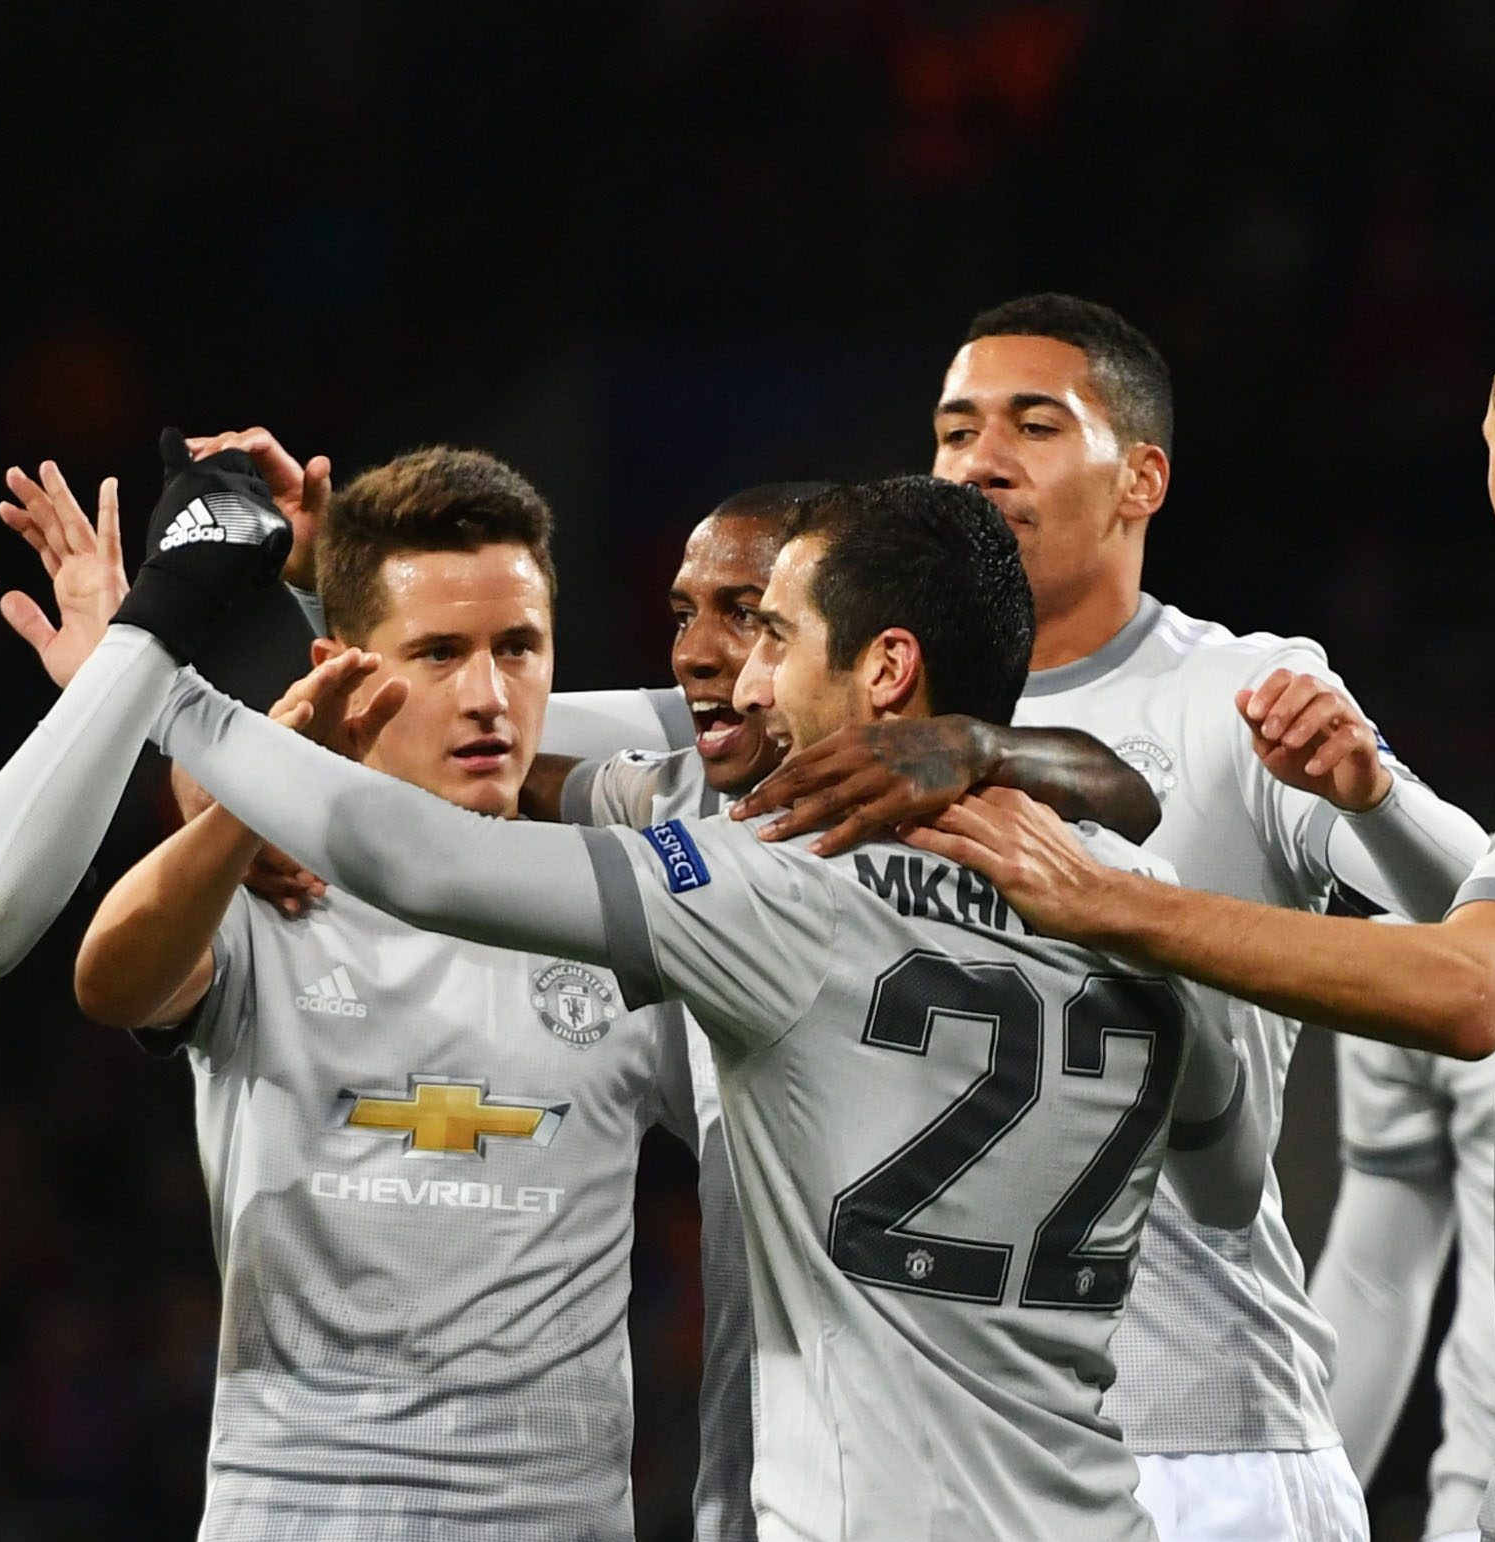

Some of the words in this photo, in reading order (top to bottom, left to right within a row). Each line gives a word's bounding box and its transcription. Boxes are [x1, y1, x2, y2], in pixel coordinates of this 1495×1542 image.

[159, 525, 225, 552] adidas
[538, 965, 610, 999] MANCHESTER
[295, 993, 367, 1018] adidas
[552, 1023, 601, 1043] UNITED
[828, 948, 1187, 1311] 22
[311, 1171, 566, 1213] CHEVROLET
